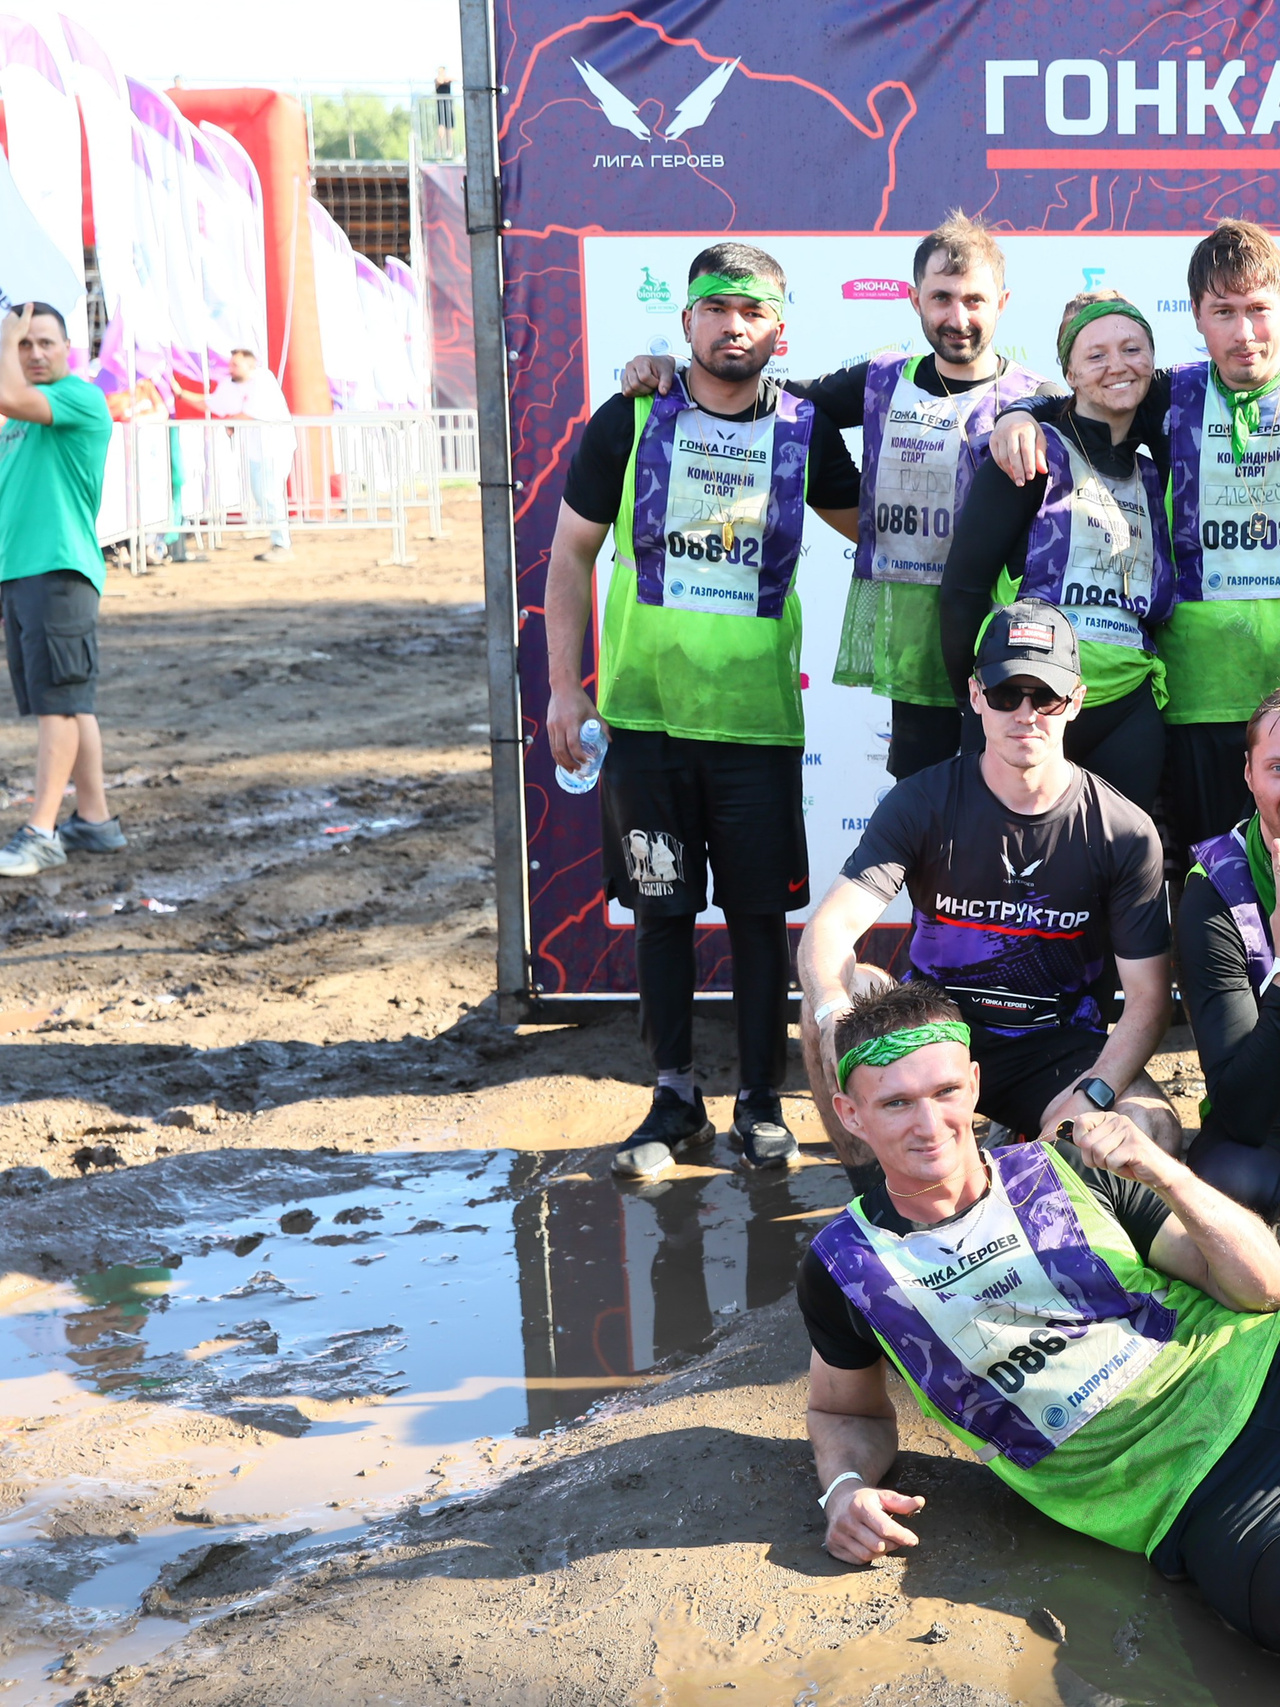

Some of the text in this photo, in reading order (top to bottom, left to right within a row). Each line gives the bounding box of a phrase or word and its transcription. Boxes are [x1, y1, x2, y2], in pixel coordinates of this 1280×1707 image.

[593, 155, 725, 168] ЛИГА ГЕРОЕВ
[853, 281, 900, 292] ЭКОНАД
[637, 289, 672, 300] bionova
[890, 410, 917, 420] ГОНКА
[1208, 424, 1232, 434] ГОН
[679, 440, 767, 460] ГОНКА ГЕРОЕВ
[891, 437, 944, 452] КОМАНДНЫЙ
[901, 452, 926, 464] СТАРТ
[687, 466, 755, 487] КОМАНДНЫЙ
[1235, 466, 1266, 477] СТАРТ
[704, 483, 735, 497] СТАРТ
[1114, 499, 1145, 513] ЕРОЕВ
[877, 503, 950, 538] 08610
[667, 531, 760, 568] 08602
[891, 559, 946, 573] ГАЗПРОМБАН
[690, 586, 755, 601] ГАЗПРОМБАНК
[935, 893, 1090, 929] ИНСТРУКТОР
[981, 998, 1027, 1009] ГОНКА ГЕРОЕВ
[958, 1233, 1019, 1271] ГЕРОЕВ
[987, 1318, 1088, 1394] 086
[1066, 1337, 1143, 1408] ГАЗПРОМБАНК
